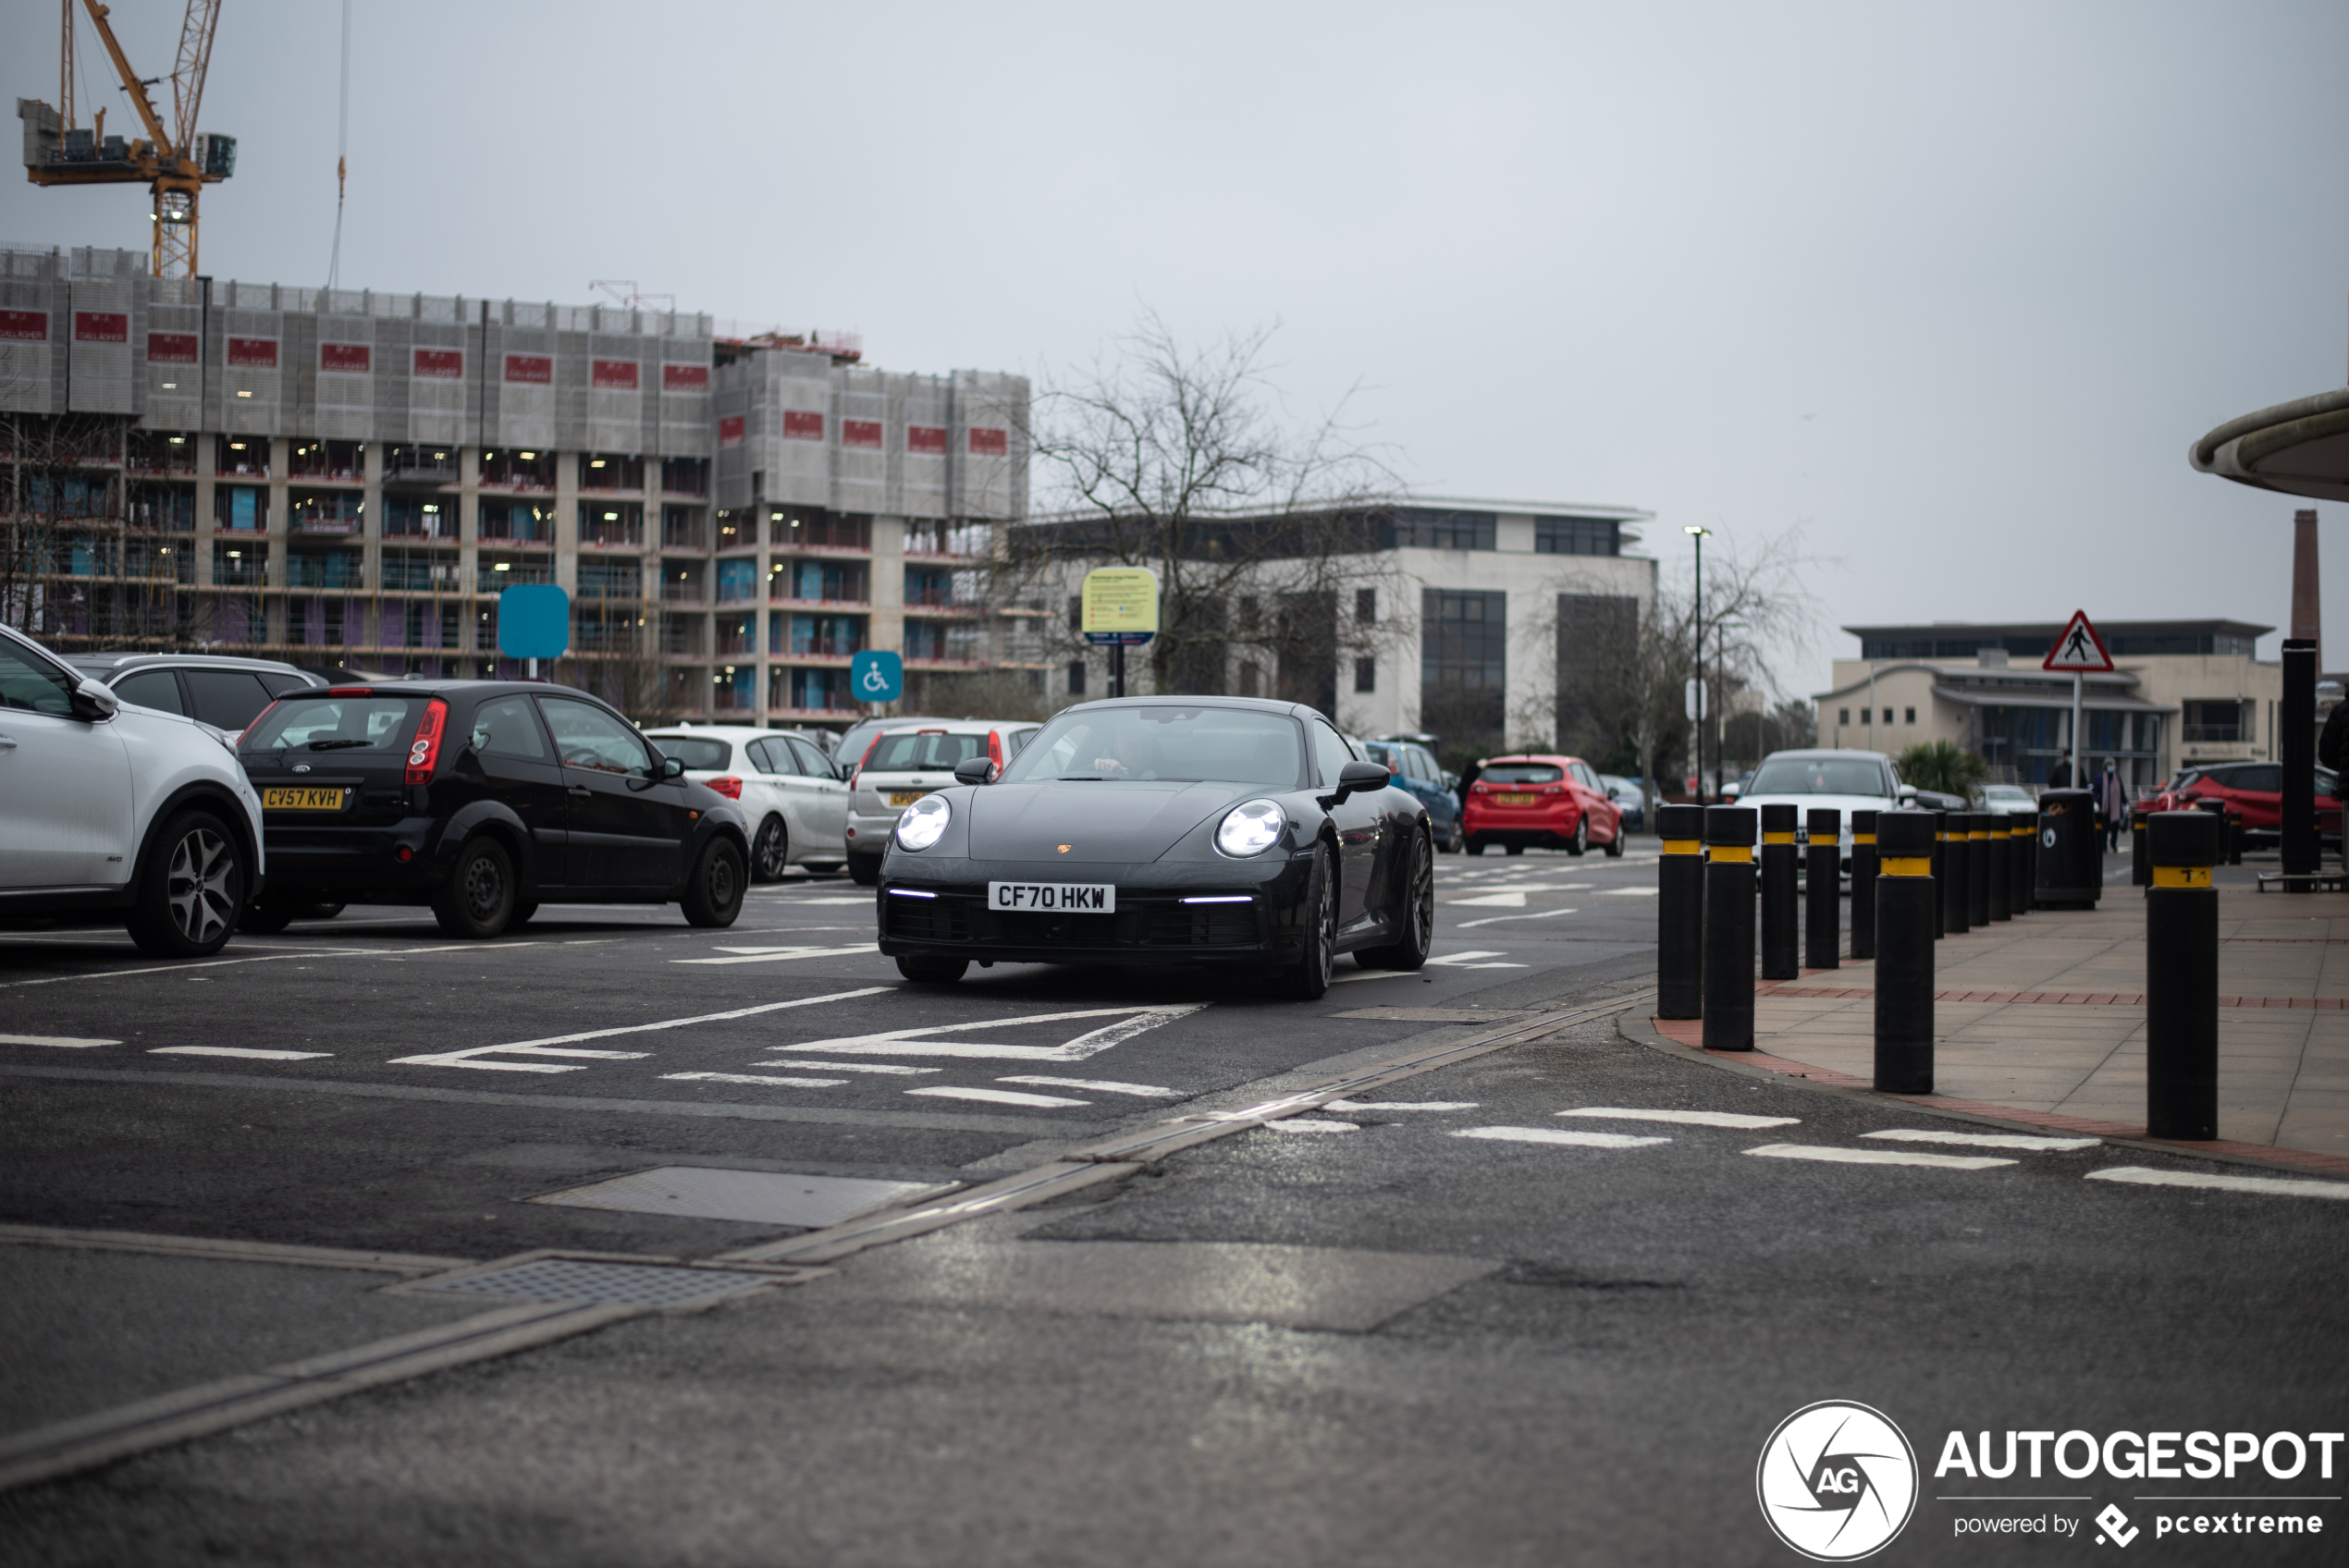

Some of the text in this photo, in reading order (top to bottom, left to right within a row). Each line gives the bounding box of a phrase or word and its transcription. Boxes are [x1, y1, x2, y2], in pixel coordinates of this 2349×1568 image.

[268, 790, 337, 806] CV57 KVH
[999, 886, 1104, 908] CF70 HKW
